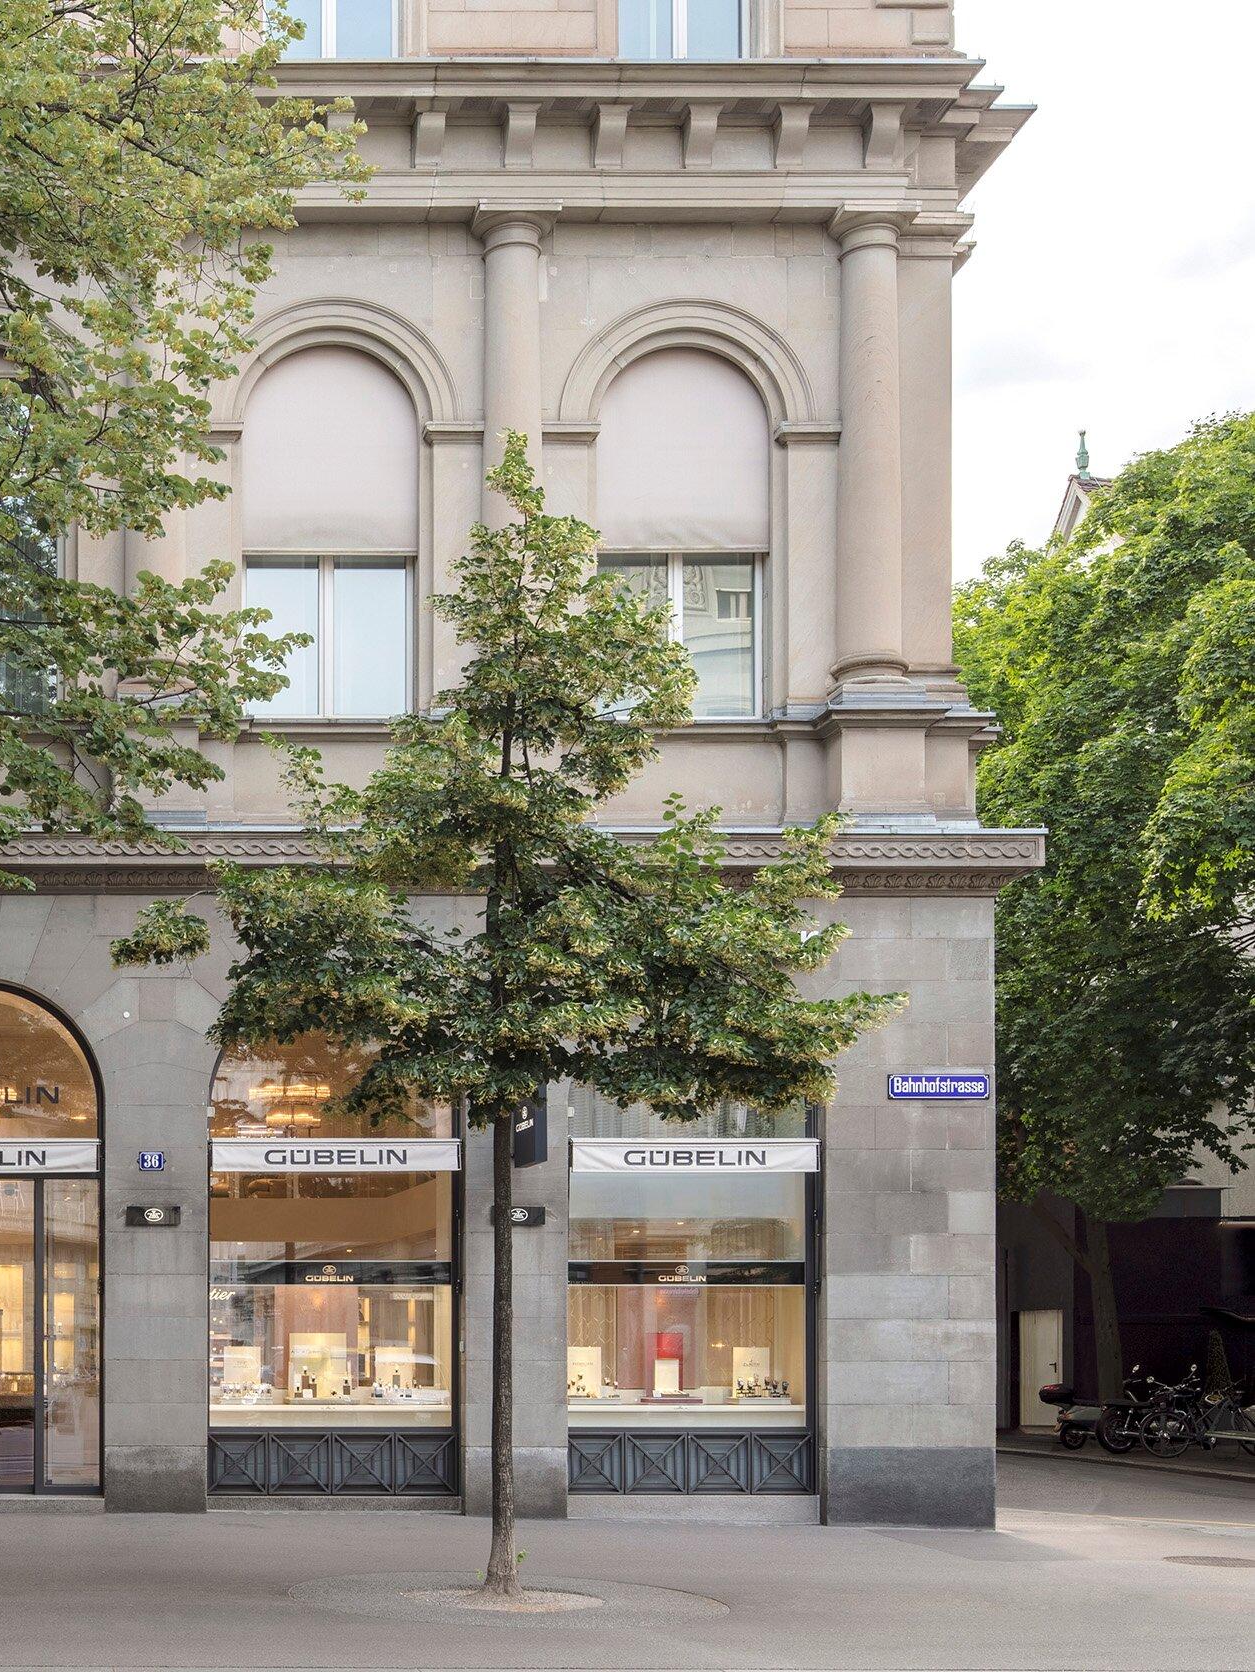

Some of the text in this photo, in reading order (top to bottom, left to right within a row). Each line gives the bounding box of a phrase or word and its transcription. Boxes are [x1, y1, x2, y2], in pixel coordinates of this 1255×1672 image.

[893, 1076, 985, 1093] Bahnhofstrasse
[144, 1154, 159, 1168] 36
[264, 1149, 407, 1166] GÜBELIN
[624, 1150, 766, 1166] GÜBELIN
[305, 1274, 354, 1282] GÜBELIN
[658, 1274, 707, 1282] GÜBELIN
